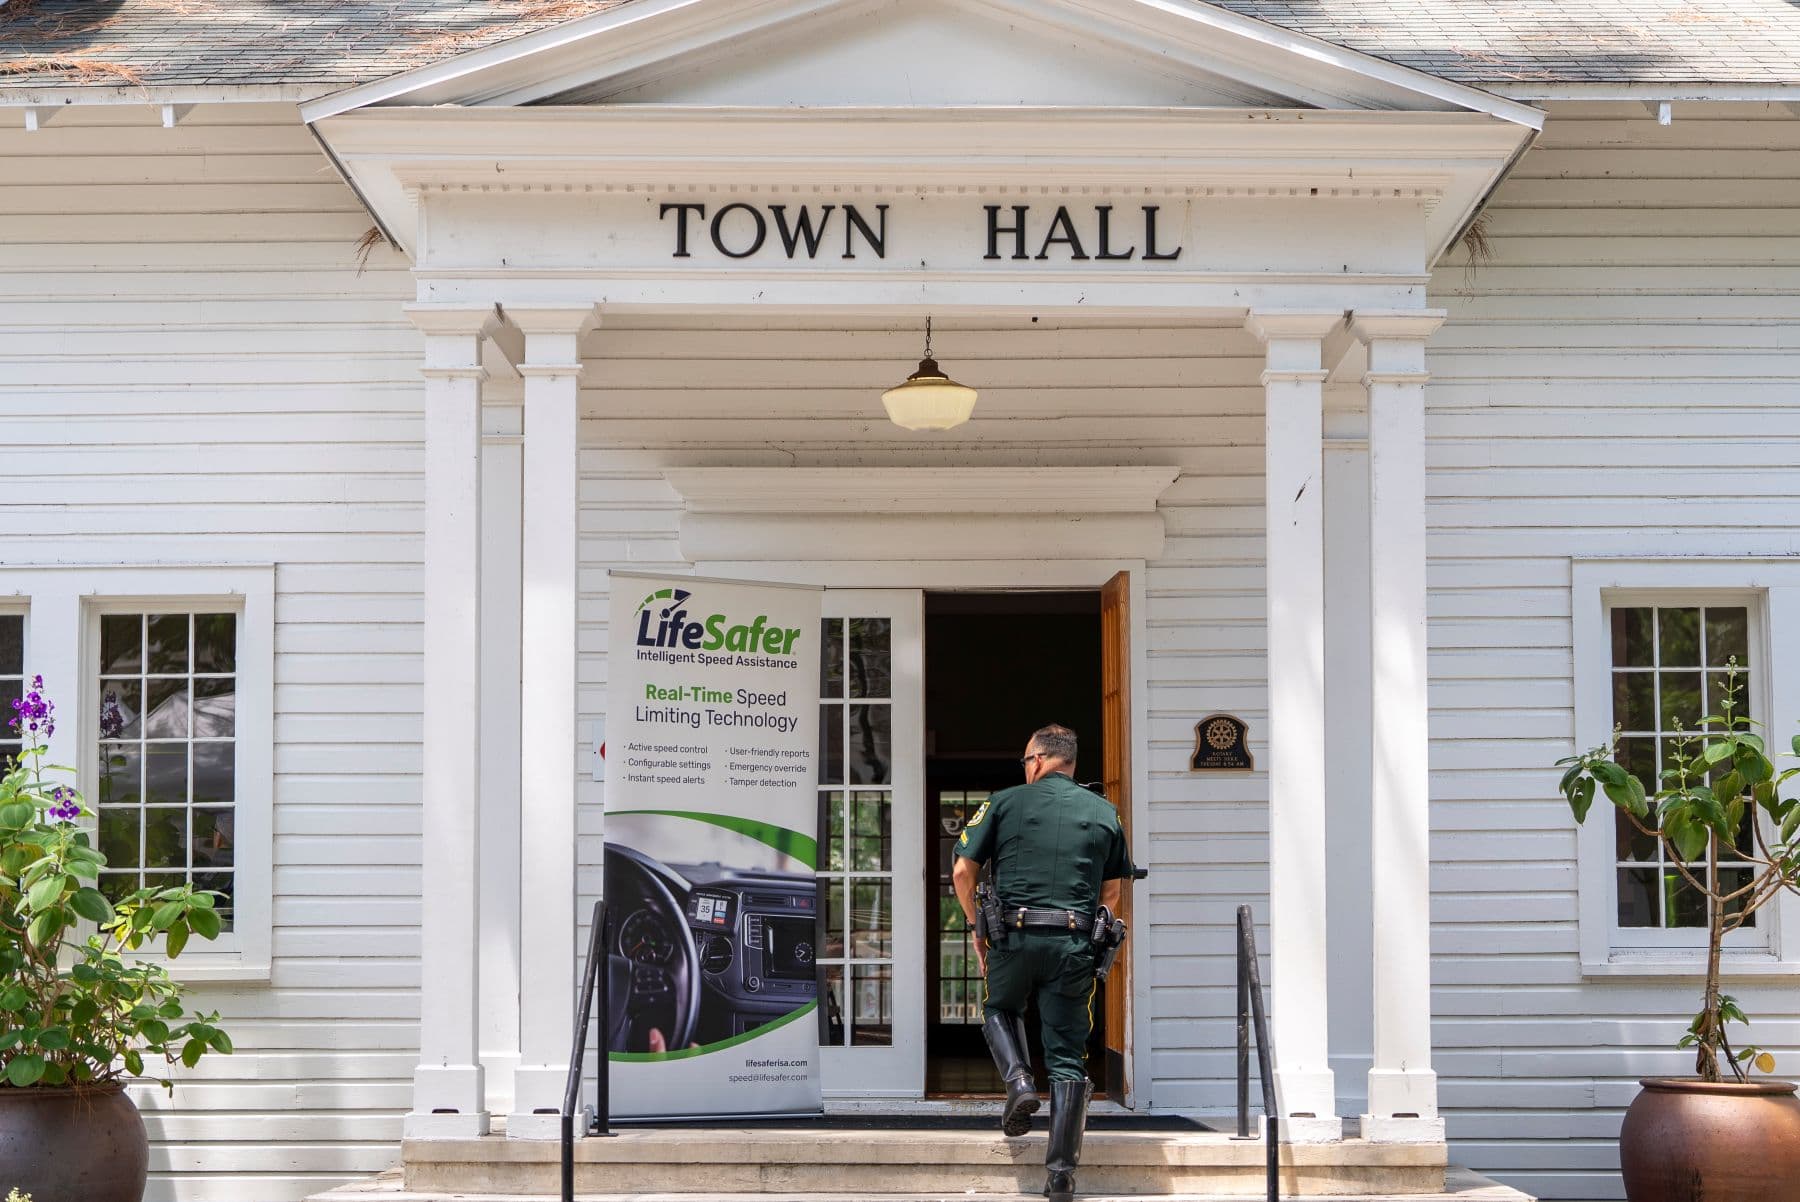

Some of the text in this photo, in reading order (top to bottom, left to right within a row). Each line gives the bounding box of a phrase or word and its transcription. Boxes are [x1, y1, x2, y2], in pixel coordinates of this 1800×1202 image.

[660, 203, 1182, 260] TOWN HALL
[637, 608, 801, 655] LifeSafer
[637, 649, 798, 669] Intelligent Speed Assistance
[646, 684, 786, 708] Real-Time Speed
[636, 706, 798, 732] Limiting Technology
[628, 743, 708, 755] Active speed control
[730, 747, 810, 759] User-friendly reports
[628, 758, 711, 771] Configurable settings
[730, 762, 807, 773] Emergency override
[628, 774, 705, 785] Instant speed alerts
[729, 778, 797, 788] Tamper detection
[700, 905, 710, 914] 35
[746, 1059, 808, 1068] lifesaferisa.com
[729, 1073, 808, 1084] speed@lifesafer.com
